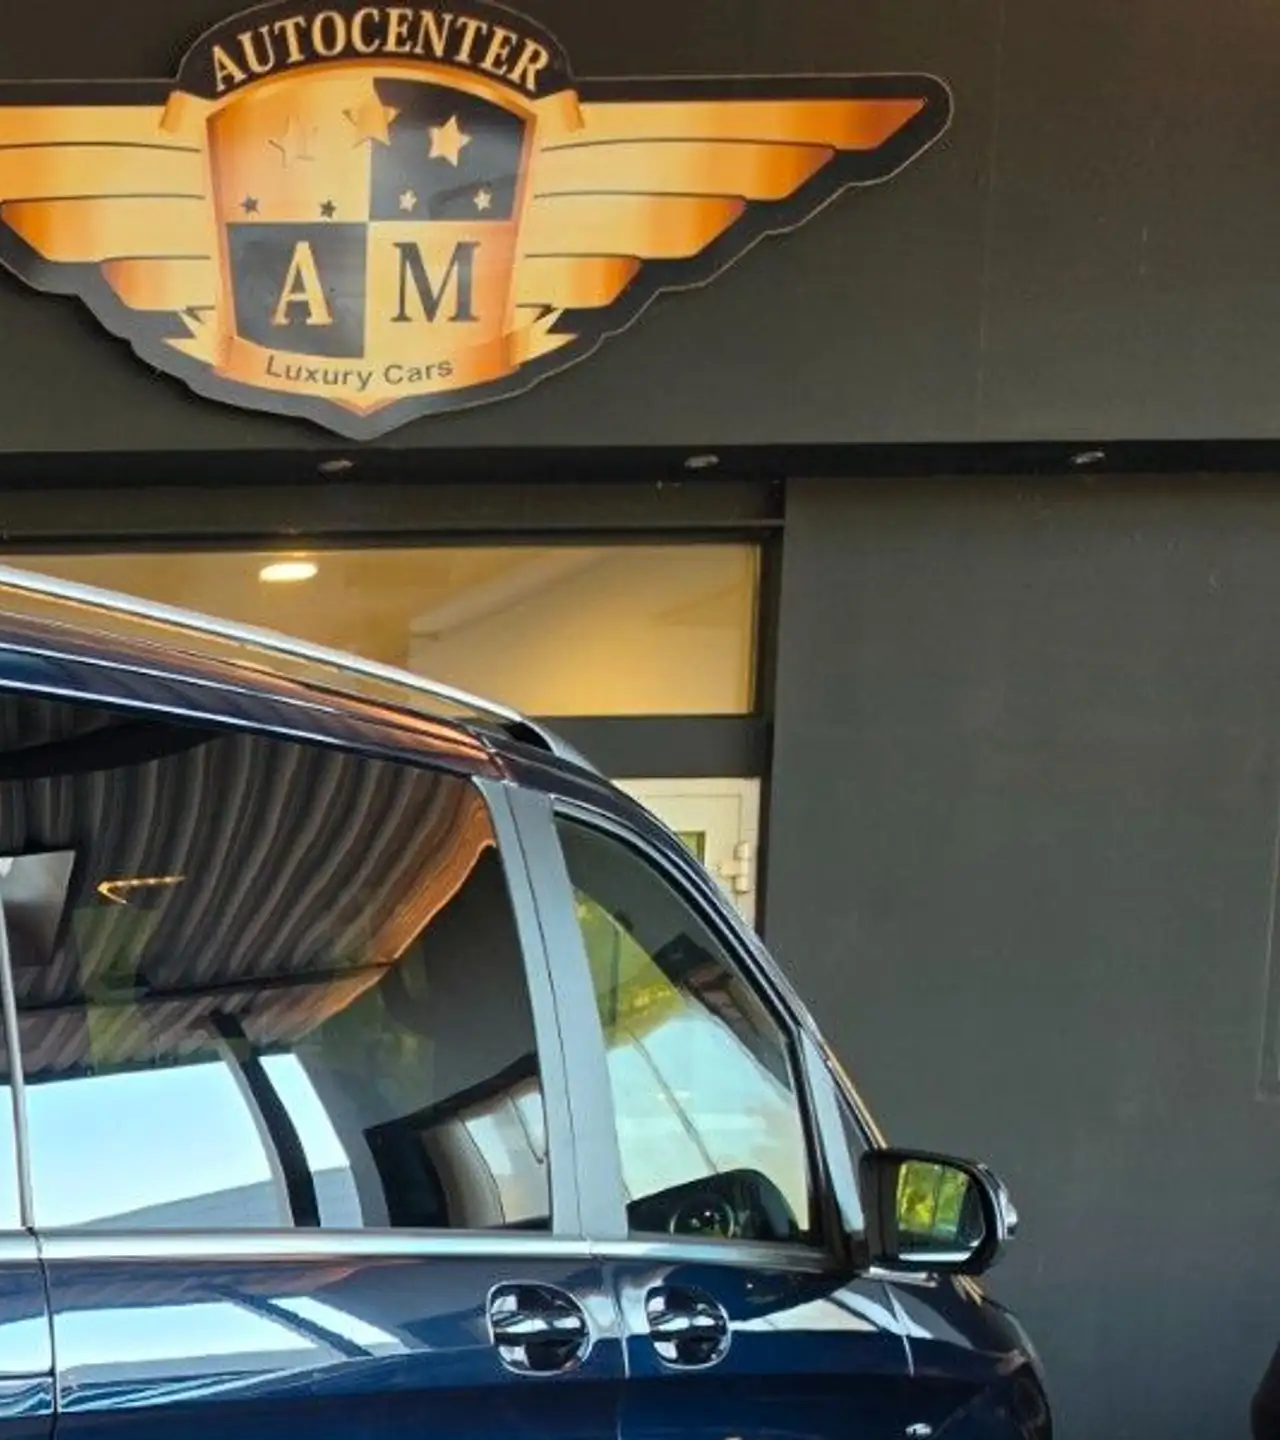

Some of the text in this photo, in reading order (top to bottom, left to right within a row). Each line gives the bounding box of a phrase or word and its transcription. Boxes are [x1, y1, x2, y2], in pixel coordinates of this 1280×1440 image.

[210, 6, 550, 92] AUTOCENTER
[271, 240, 482, 326] A M
[265, 354, 454, 391] Luxury Cars
